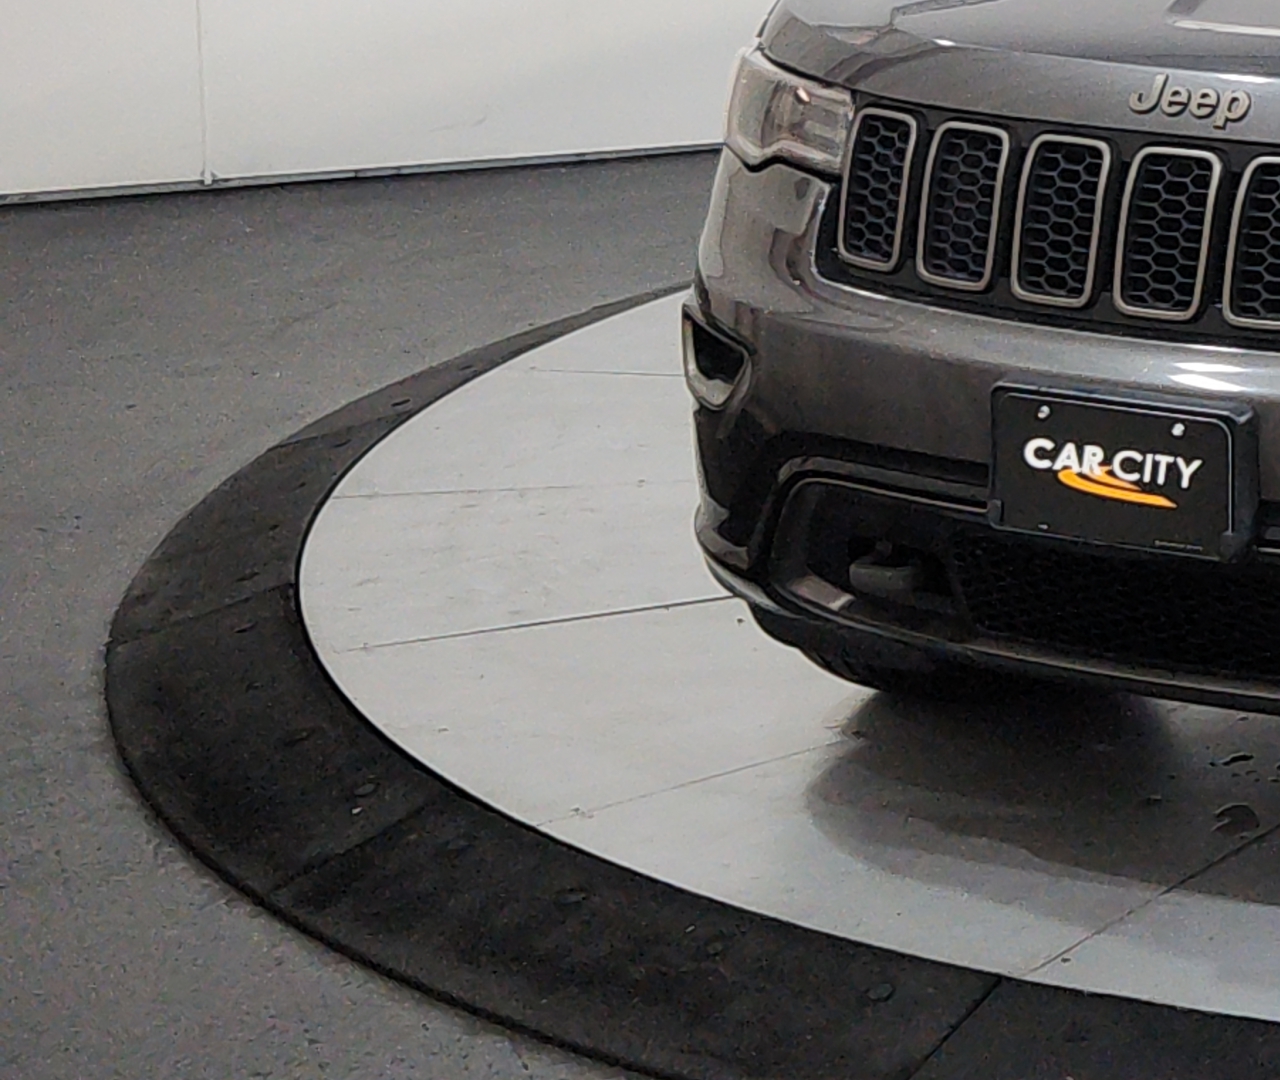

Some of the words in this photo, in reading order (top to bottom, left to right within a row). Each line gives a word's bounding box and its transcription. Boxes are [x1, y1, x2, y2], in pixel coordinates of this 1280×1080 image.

[1129, 73, 1251, 130] Jeep
[1023, 438, 1105, 475] CAR
[1111, 450, 1202, 489] CITY
